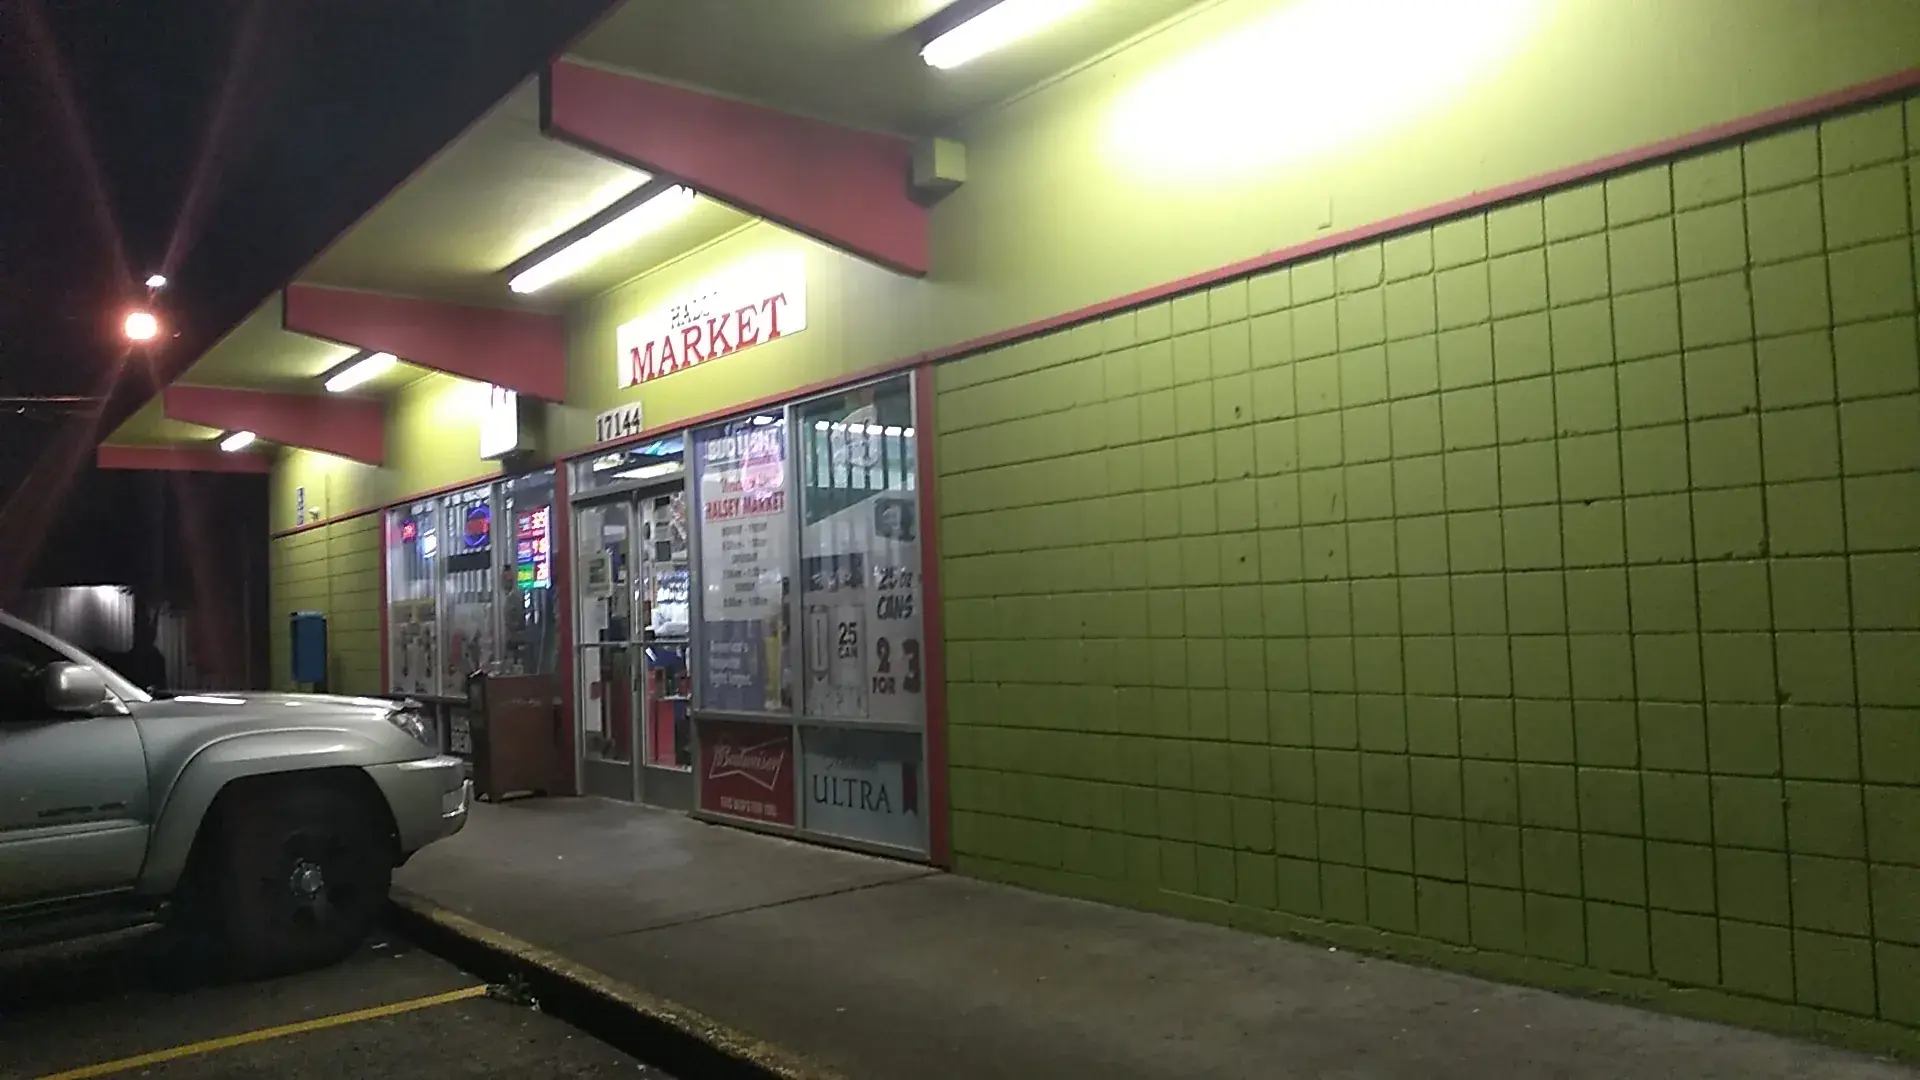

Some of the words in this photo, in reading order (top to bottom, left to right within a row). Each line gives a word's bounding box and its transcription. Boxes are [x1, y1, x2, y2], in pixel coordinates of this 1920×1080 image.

[630, 292, 788, 386] MARKET
[597, 406, 641, 442] 17144
[838, 622, 857, 645] 25
[876, 637, 891, 673] 2
[902, 638, 921, 694] 3
[813, 774, 892, 814] ULTRA
